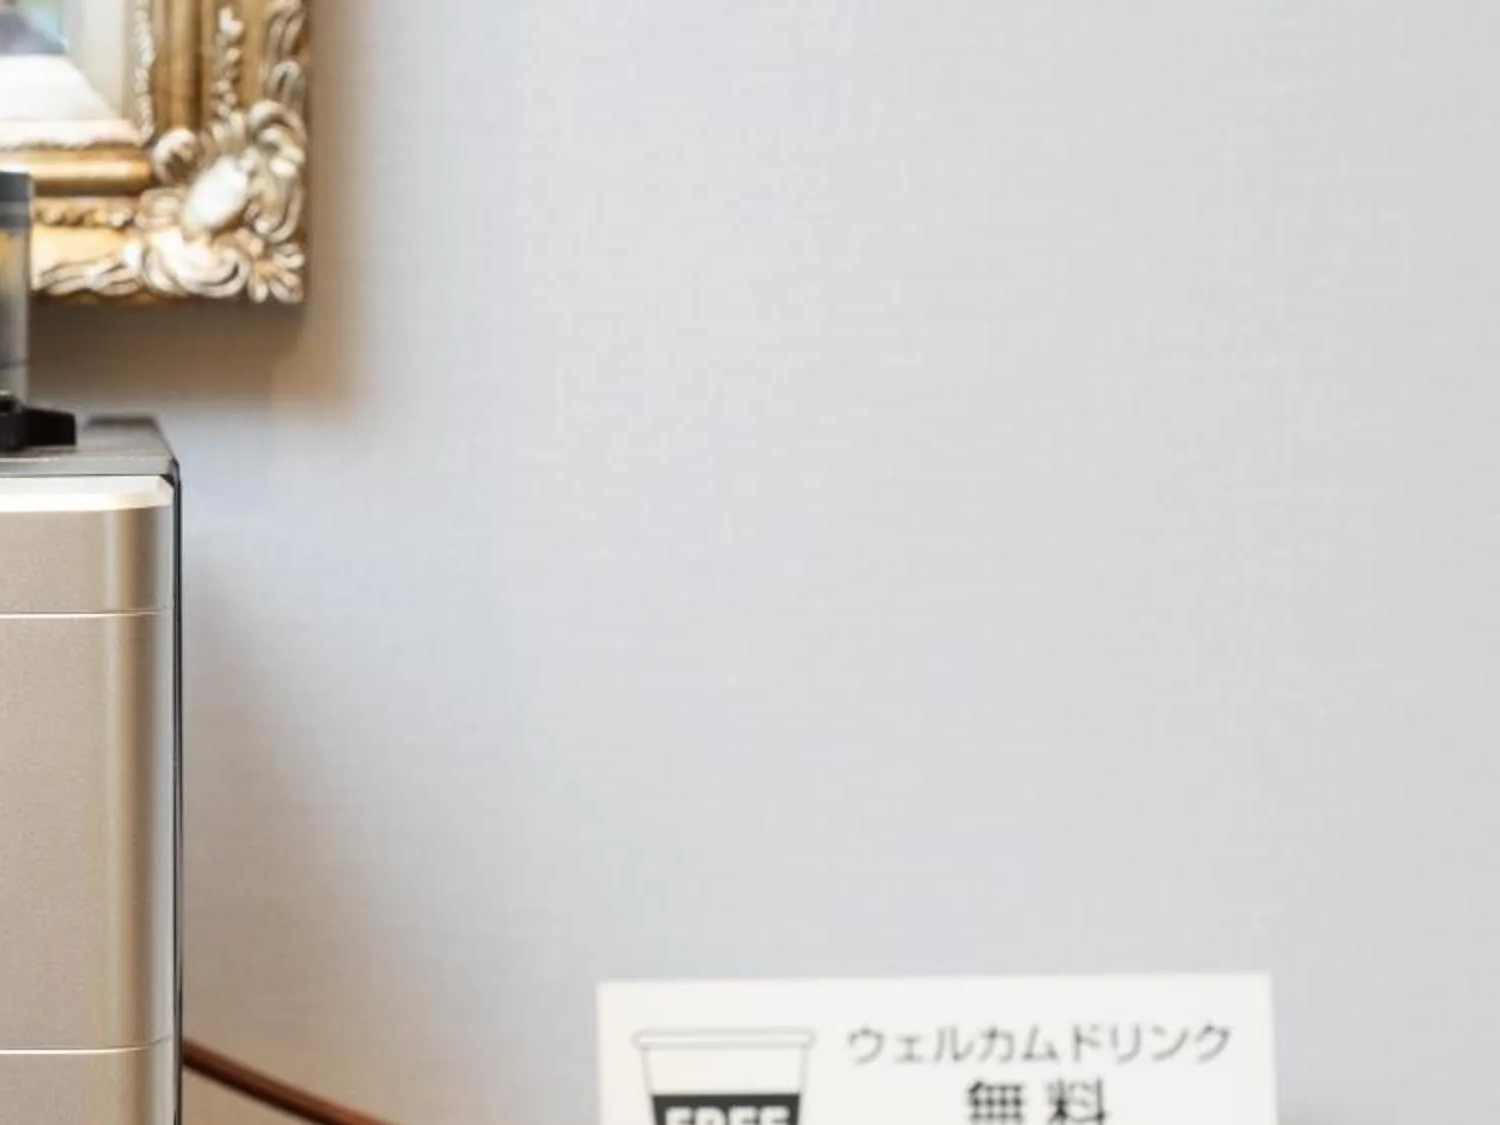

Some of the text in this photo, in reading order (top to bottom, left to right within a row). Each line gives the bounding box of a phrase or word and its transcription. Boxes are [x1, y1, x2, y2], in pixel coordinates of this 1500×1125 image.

[847, 1023, 1232, 1065] ウェルカムドリンク
